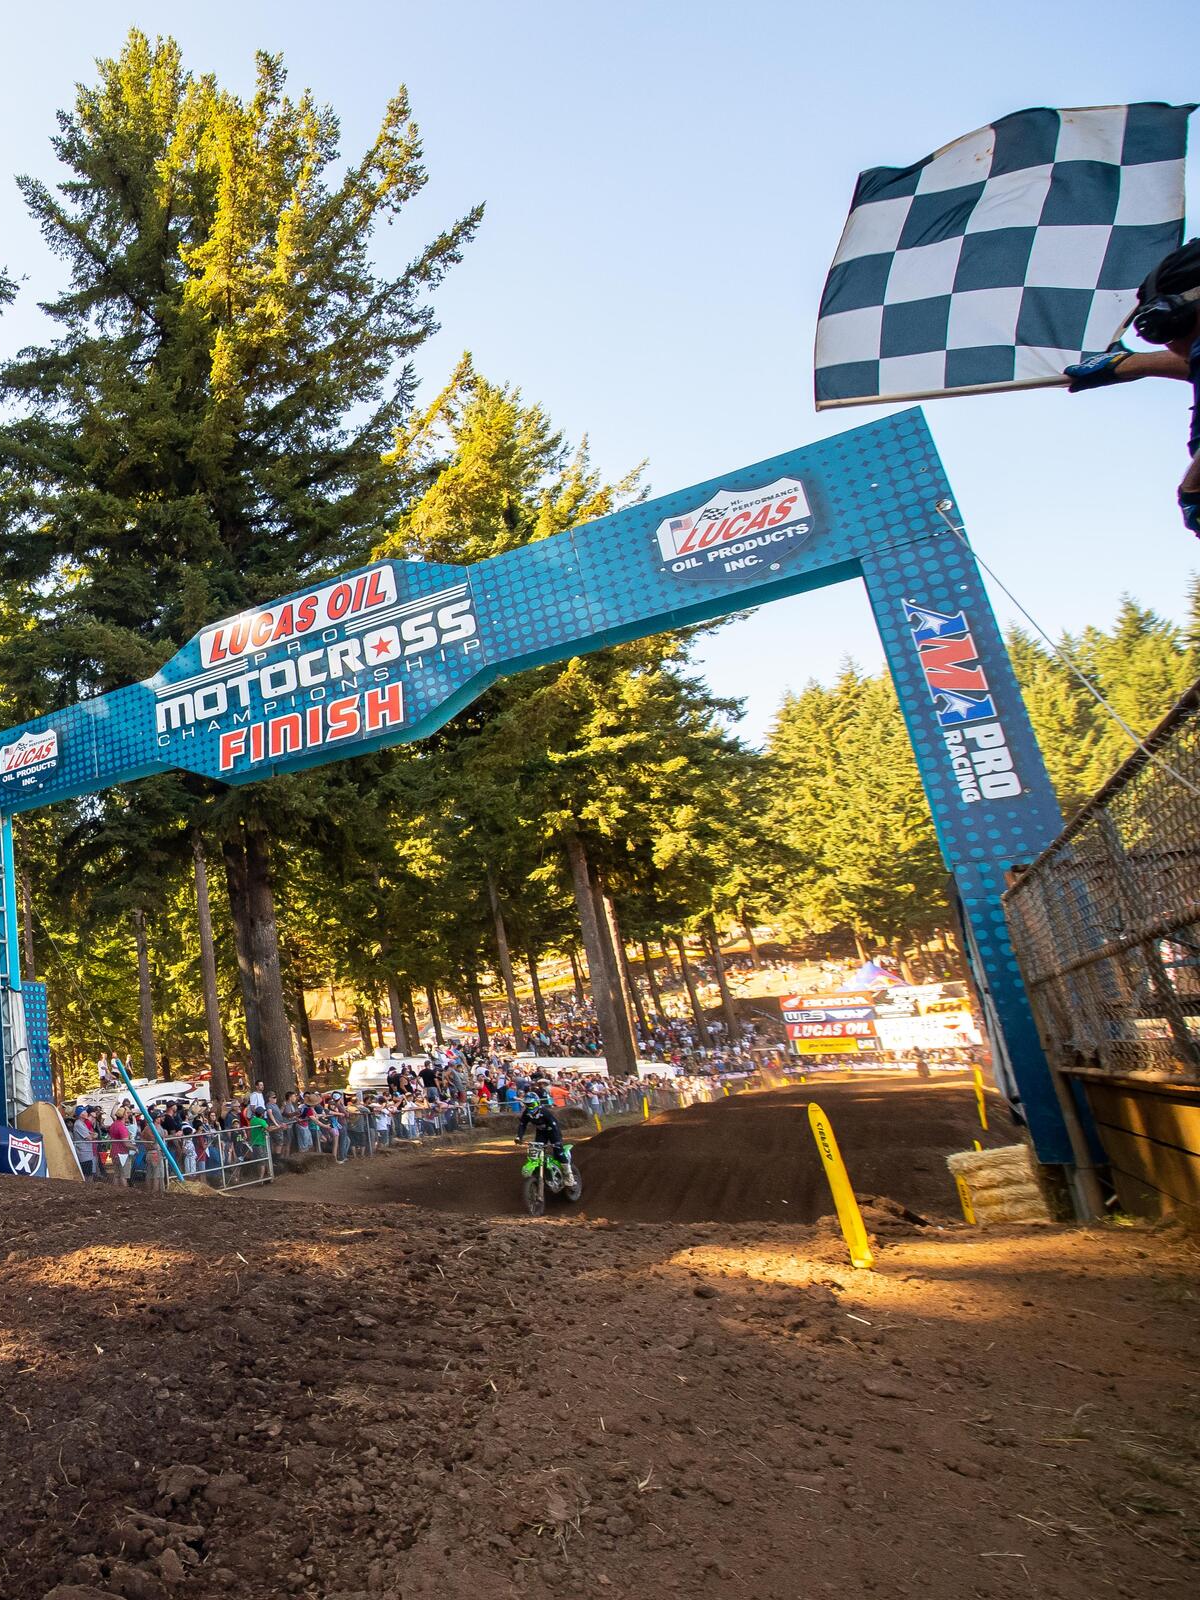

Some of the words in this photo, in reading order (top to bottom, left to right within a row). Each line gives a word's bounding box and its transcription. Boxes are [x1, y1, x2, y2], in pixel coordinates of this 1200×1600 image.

[732, 486, 799, 513] PERFORMANCE
[671, 556, 704, 573] OIL
[707, 522, 810, 563] PRODUCTS
[676, 495, 798, 555] LUCAS
[724, 554, 764, 573] INC.
[208, 594, 320, 664] LUCAS
[325, 569, 388, 620] OIL
[156, 599, 477, 733] MOTOCROSS
[253, 627, 339, 666] PRO
[901, 598, 997, 727] AMA
[157, 637, 481, 748] CHAMPIONSHIP
[218, 680, 405, 773] FINISH
[2, 773, 16, 783] OIL
[16, 759, 57, 779] PRODUCTS
[5, 740, 56, 771] LUCAS
[942, 729, 982, 804] RACING
[962, 721, 1022, 800] PRO
[22, 776, 38, 787] INC.
[792, 1023, 844, 1038] LUCAS
[844, 1021, 872, 1036] OIL
[11, 1140, 40, 1153] RACER
[16, 1150, 34, 1173] X
